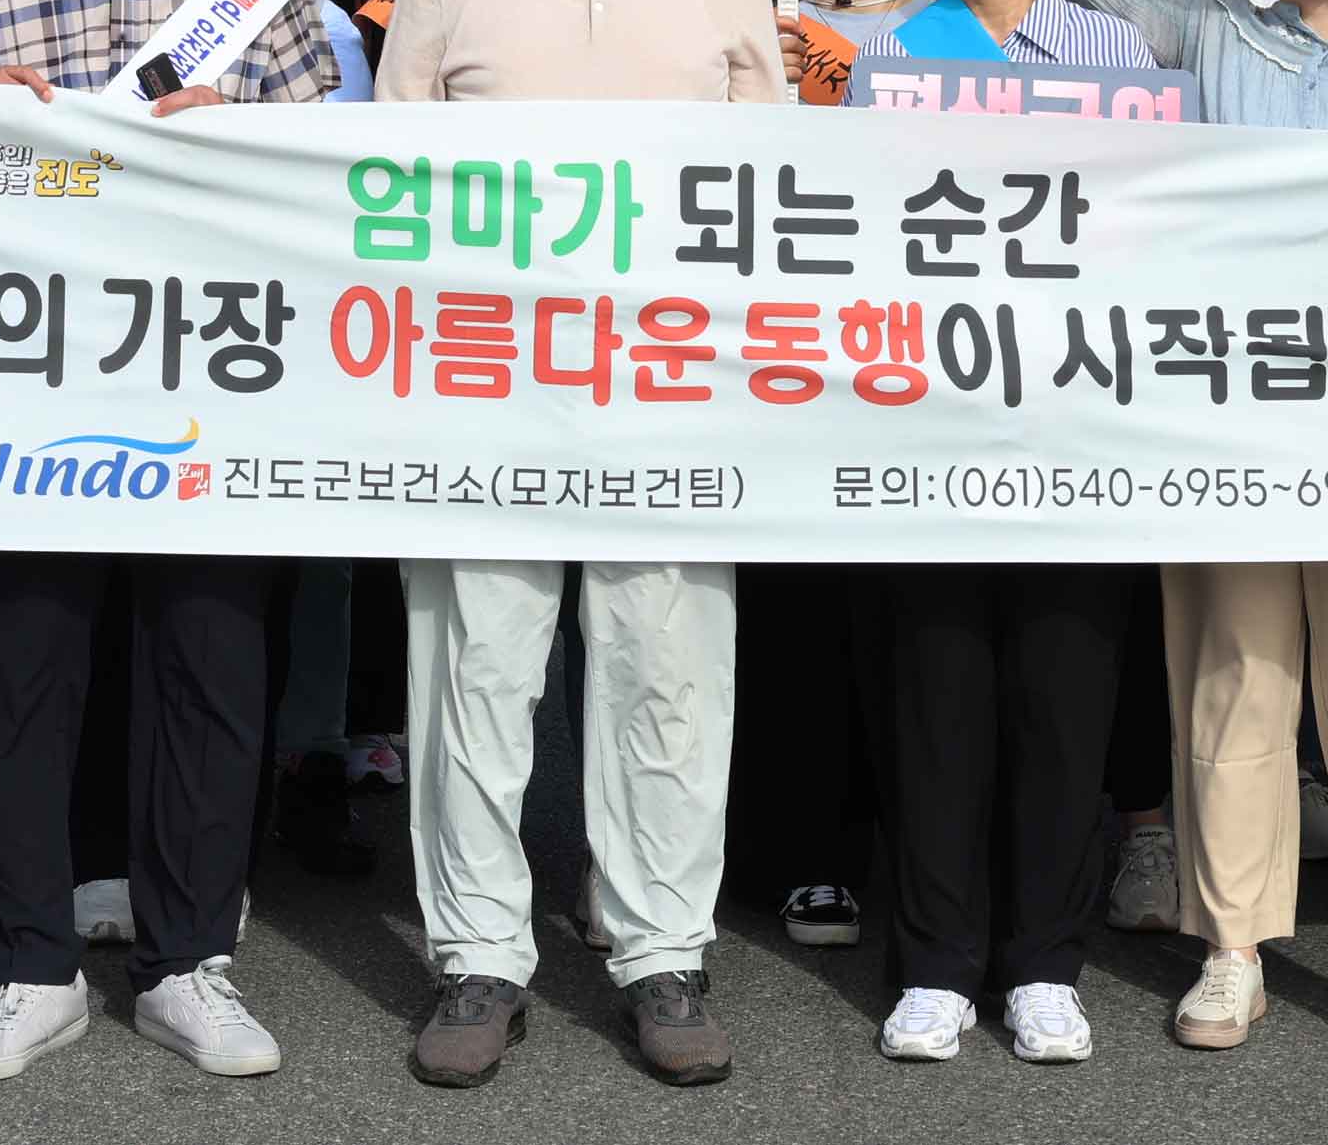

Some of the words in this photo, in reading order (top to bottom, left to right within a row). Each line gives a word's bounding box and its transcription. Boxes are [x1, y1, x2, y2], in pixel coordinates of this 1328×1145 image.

[34, 159, 100, 197] 진도
[346, 155, 644, 275] 엄마가
[675, 161, 860, 277] 되는
[900, 168, 1090, 280] 순간
[98, 277, 297, 395] 가장
[328, 283, 711, 407] 아름다운
[740, 299, 1023, 410] 동행이
[223, 457, 746, 512] 진도군보건소(모자보건팀)
